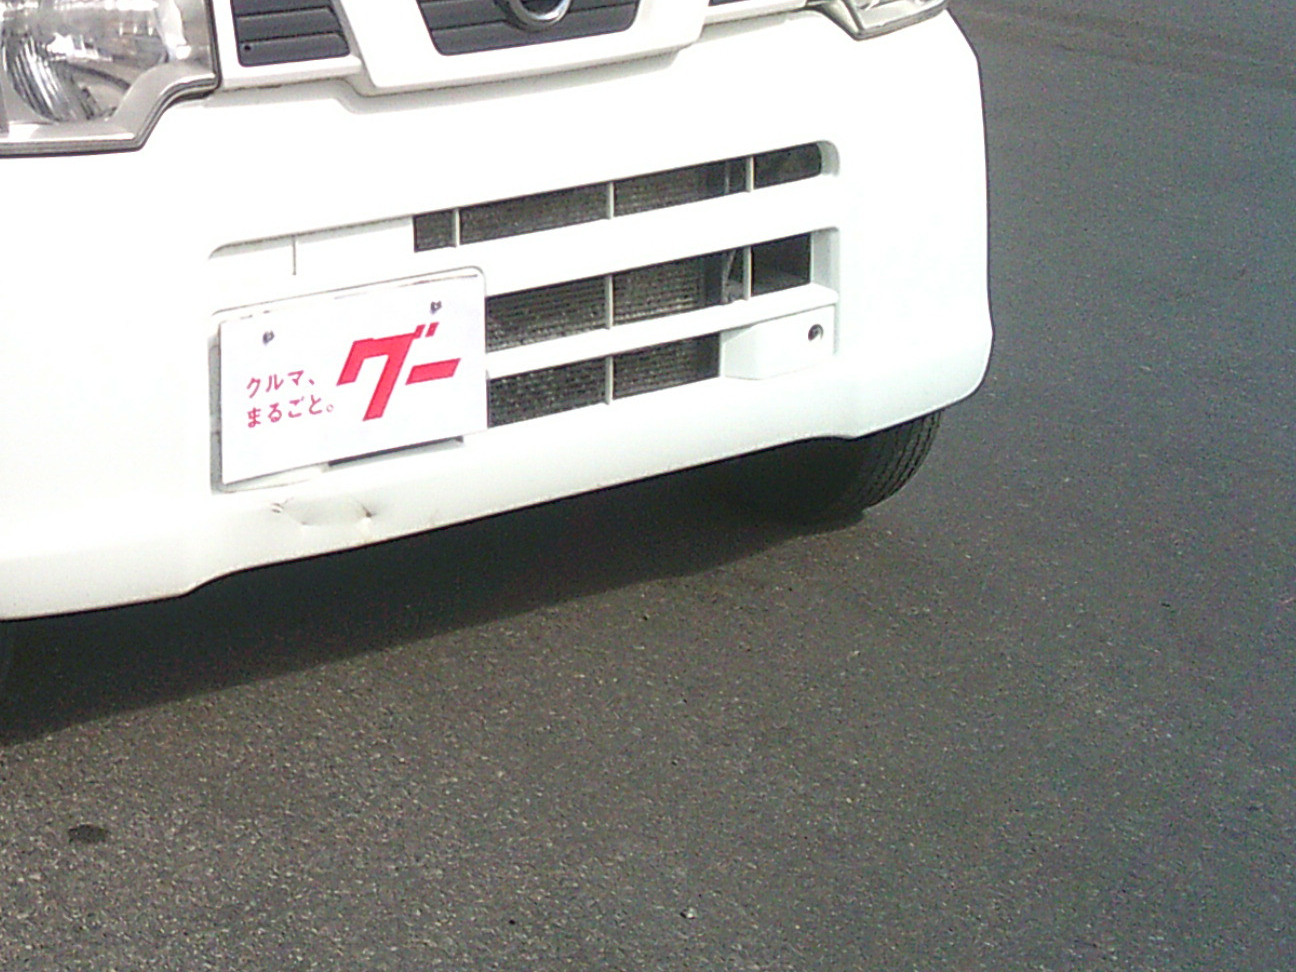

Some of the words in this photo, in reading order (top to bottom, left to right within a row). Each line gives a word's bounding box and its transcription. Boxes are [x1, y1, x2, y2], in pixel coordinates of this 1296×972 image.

[336, 322, 461, 421] グー
[246, 395, 334, 428] まるごと。
